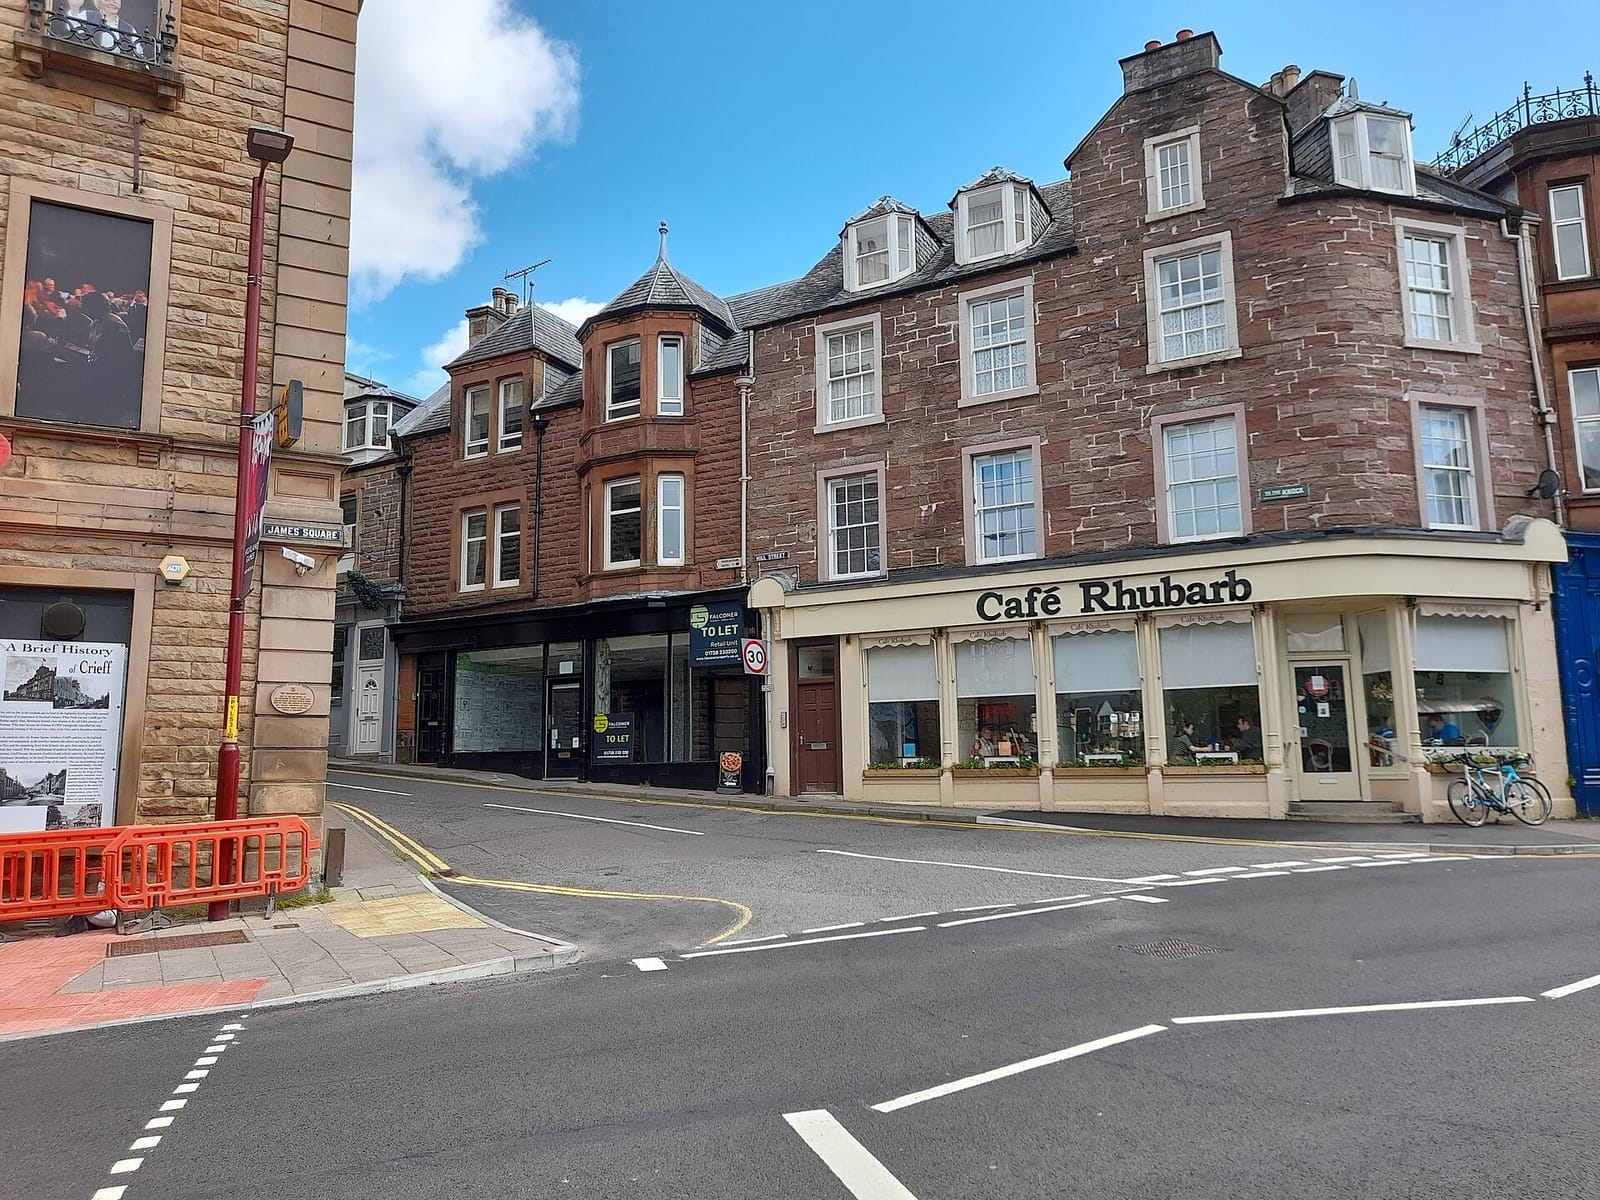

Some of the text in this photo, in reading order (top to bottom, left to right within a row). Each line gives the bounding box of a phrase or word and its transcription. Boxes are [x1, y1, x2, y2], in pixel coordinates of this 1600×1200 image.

[267, 526, 338, 539] JAMES SQUARE
[976, 570, 1252, 621] Café Rhubarb
[709, 611, 738, 619] FALCONER
[700, 624, 739, 638] TO LET
[5, 642, 114, 657] A Brief History
[710, 640, 726, 648] Retail
[747, 650, 764, 664] 30
[68, 660, 113, 675] of Crieff
[605, 734, 630, 743] TO LET
